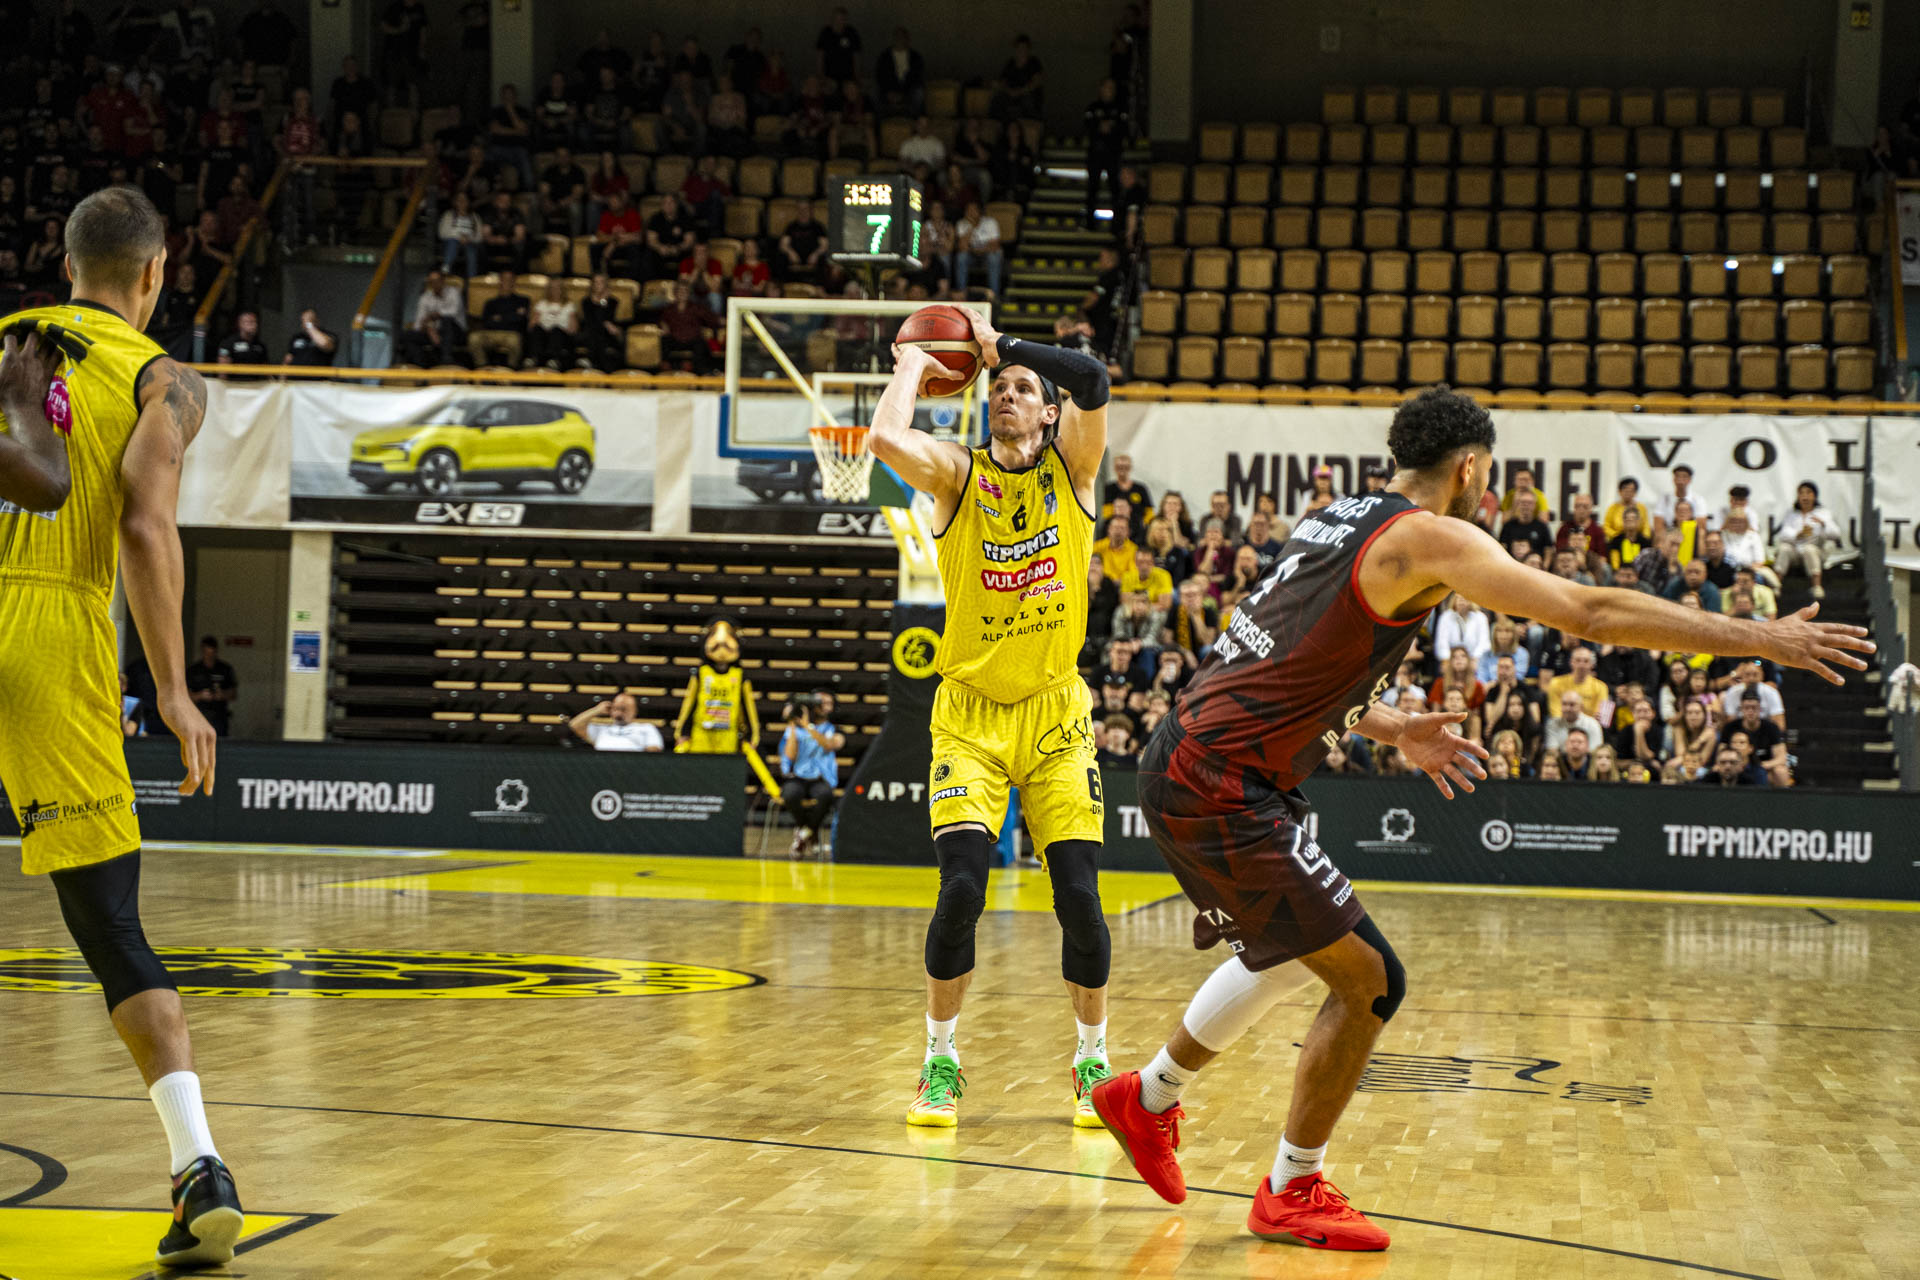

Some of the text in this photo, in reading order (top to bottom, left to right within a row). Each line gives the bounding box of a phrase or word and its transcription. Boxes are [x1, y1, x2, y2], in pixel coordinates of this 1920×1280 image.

[867, 214, 892, 255] 7
[1012, 504, 1027, 533] 6
[983, 560, 1055, 590] VULCANO
[981, 603, 1065, 626] VOLVO
[237, 778, 434, 814] TIPPMIXPRO.HU
[1663, 824, 1872, 863] TIPPMIXPRO.HU
